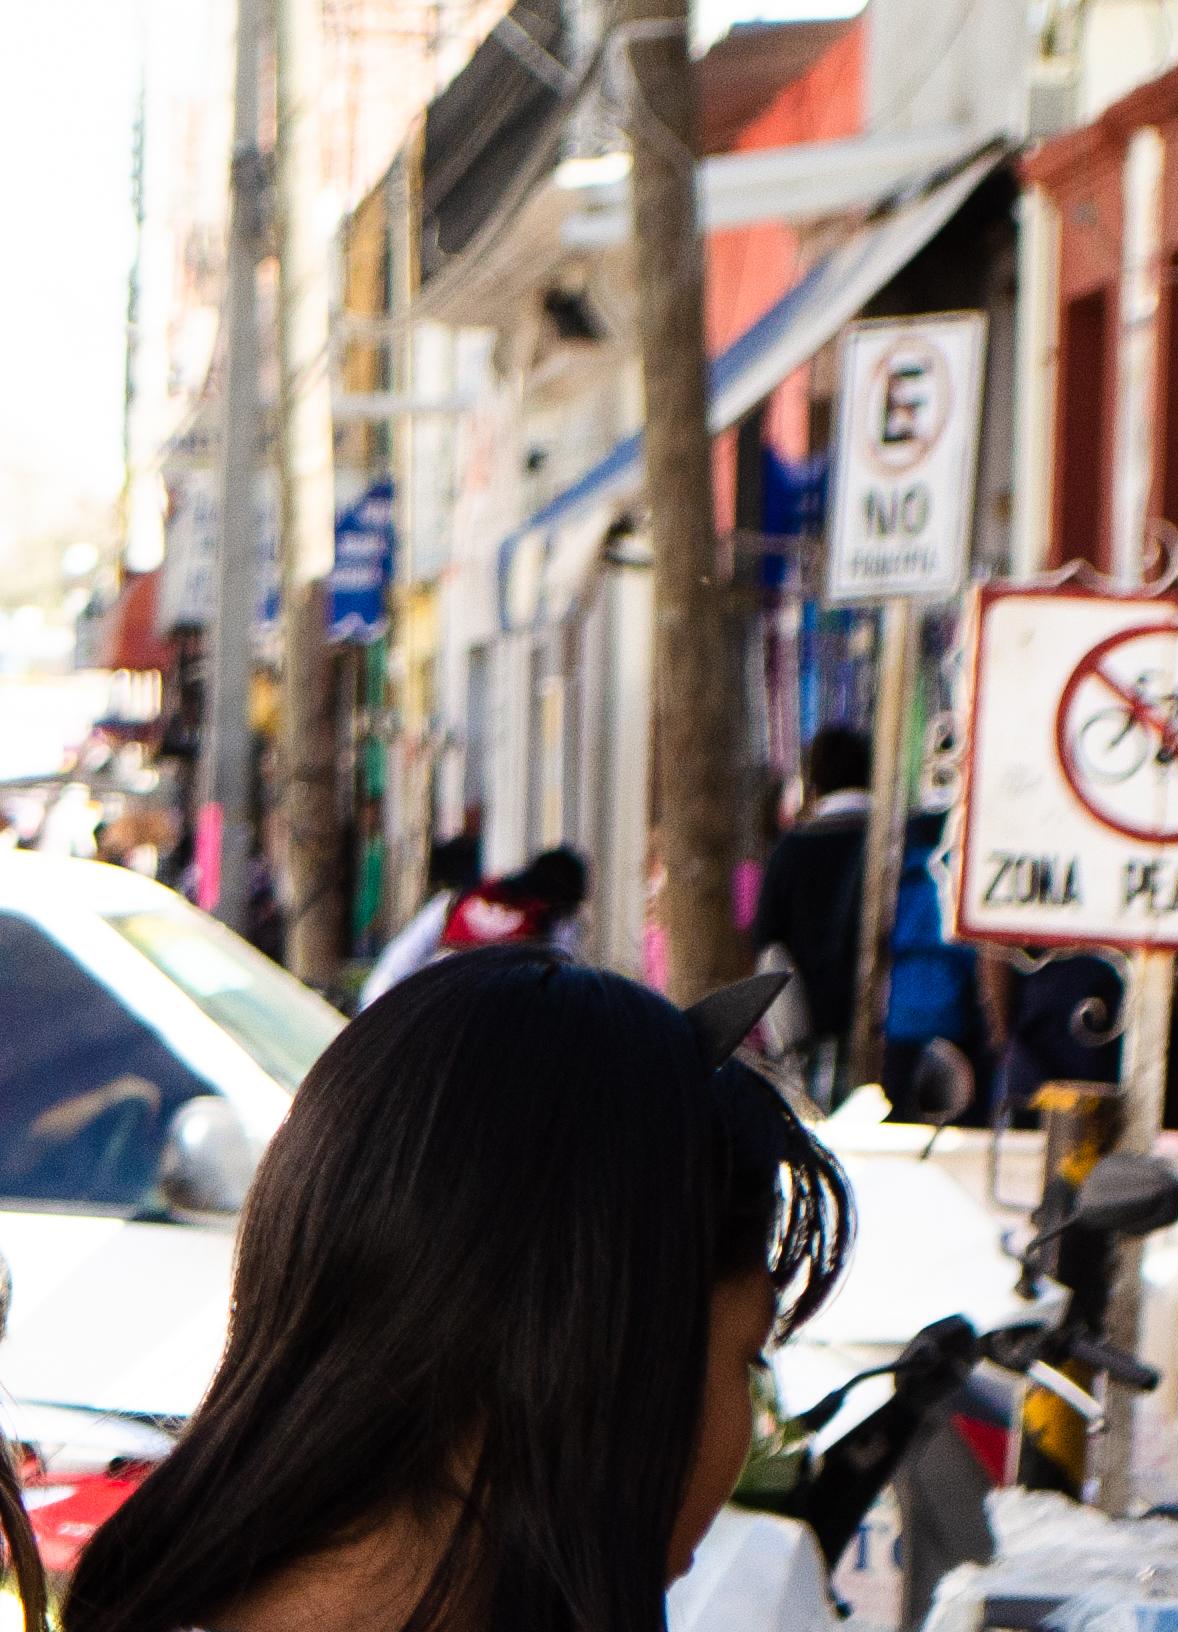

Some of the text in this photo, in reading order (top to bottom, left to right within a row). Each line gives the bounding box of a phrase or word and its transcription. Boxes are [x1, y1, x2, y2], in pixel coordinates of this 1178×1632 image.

[881, 361, 930, 444] E
[861, 482, 932, 538] NO
[982, 850, 1083, 908] ZONA
